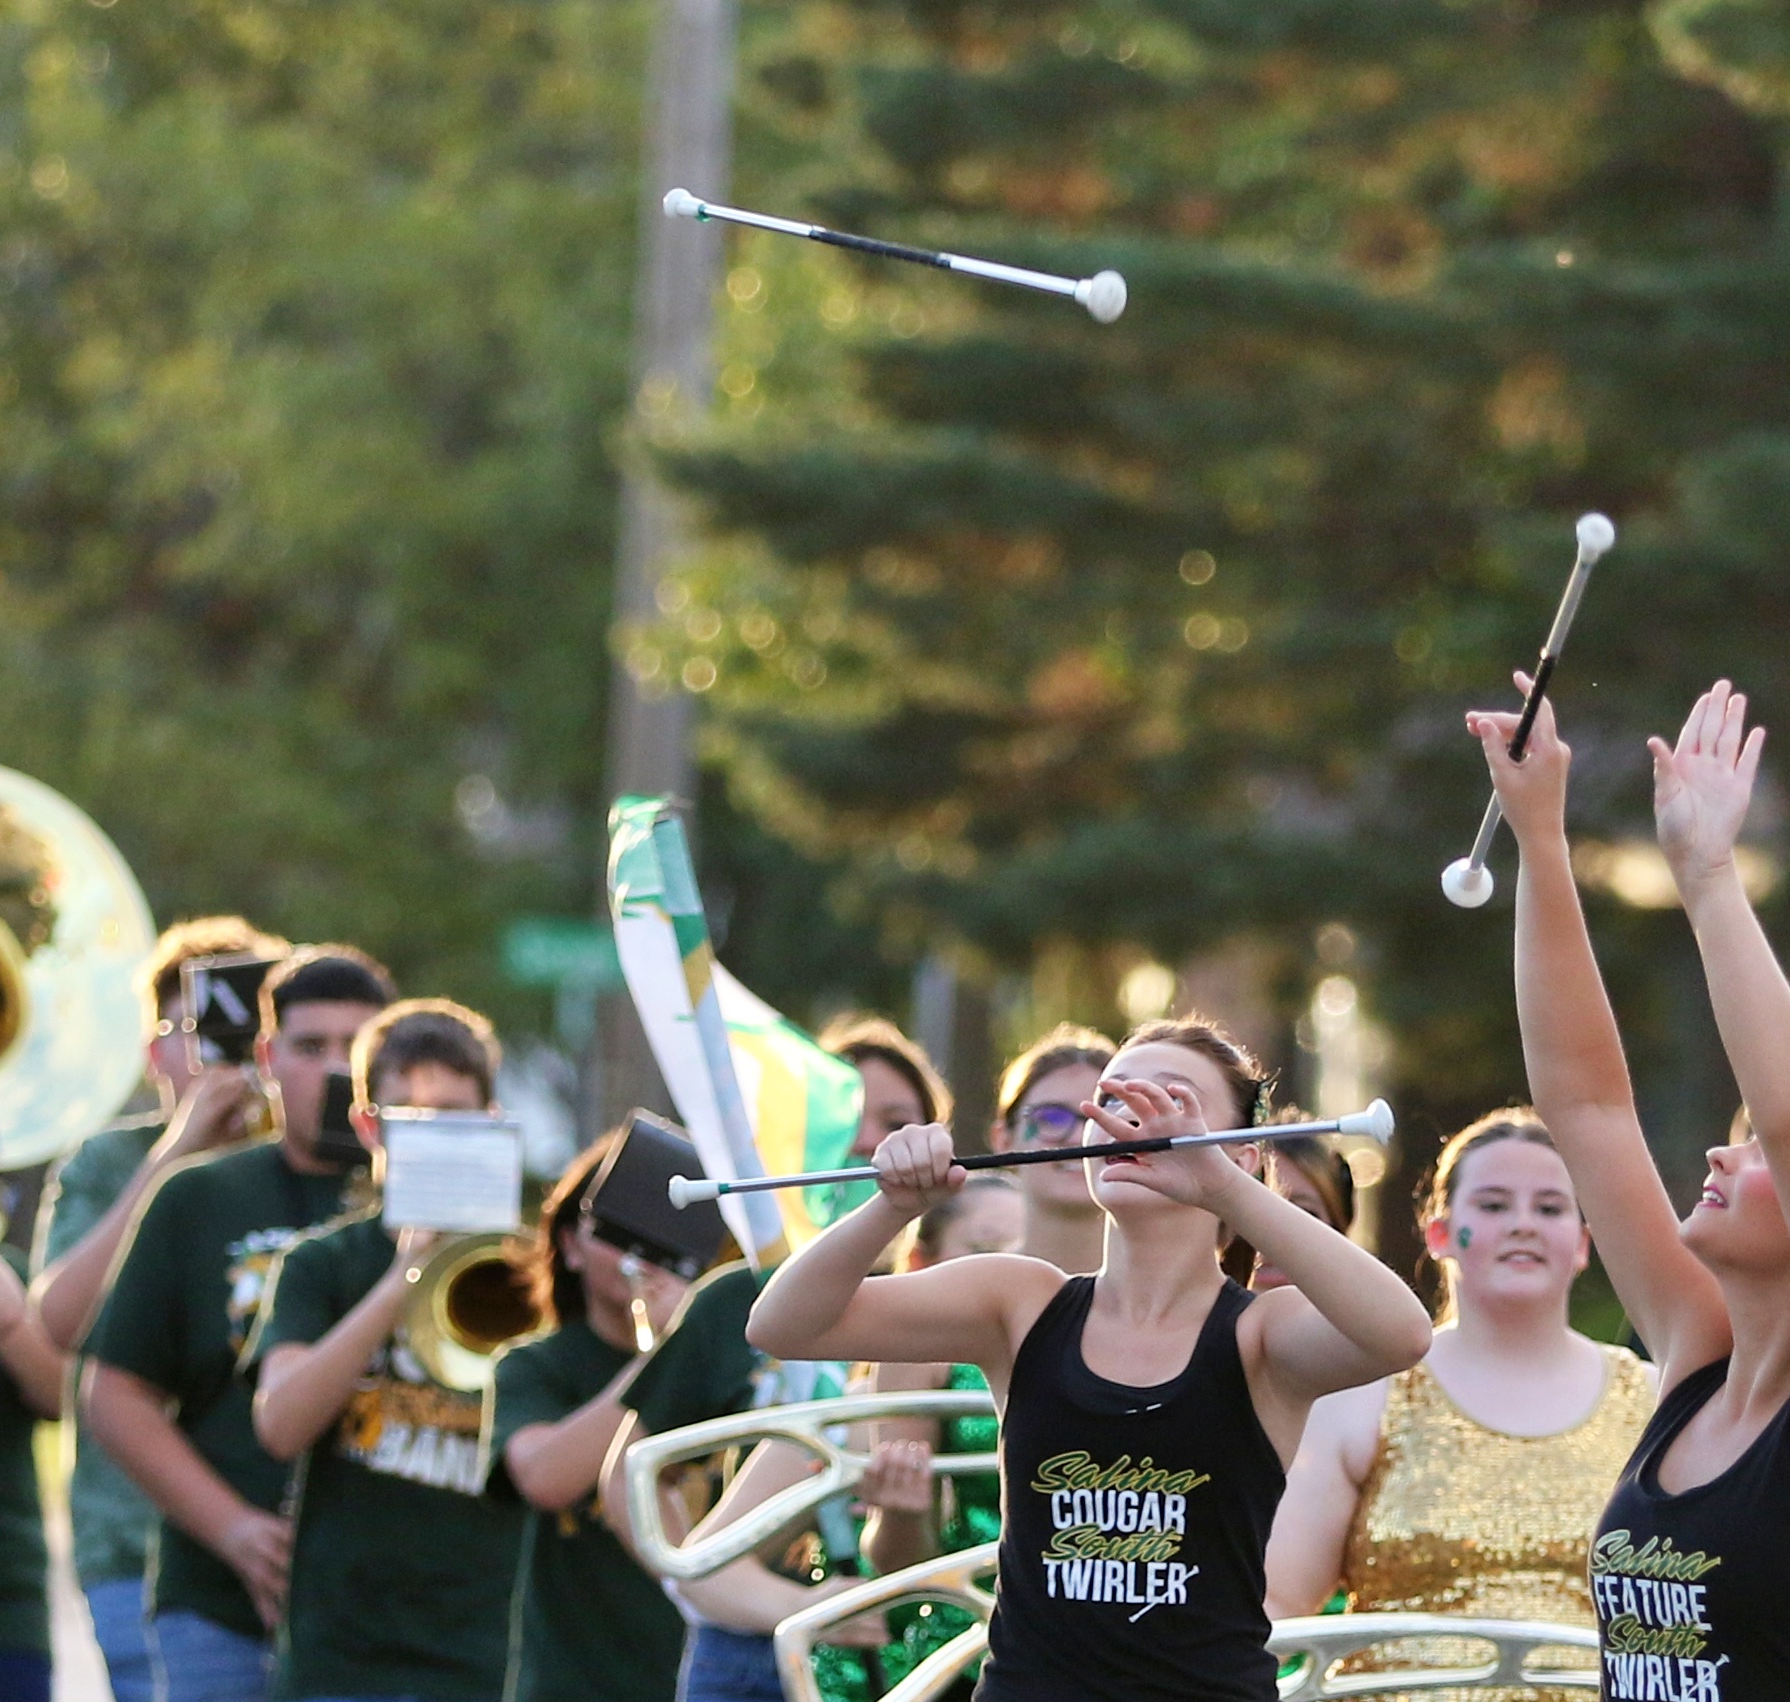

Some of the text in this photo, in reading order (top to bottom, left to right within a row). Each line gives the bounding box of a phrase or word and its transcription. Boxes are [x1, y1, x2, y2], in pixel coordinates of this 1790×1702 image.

[1030, 1451, 1211, 1494] Salina
[1052, 1489, 1186, 1534] COUGAR
[1041, 1523, 1183, 1562] South
[1590, 1529, 1721, 1580] Salina
[1042, 1556, 1188, 1604] TWIRLER
[1594, 1575, 1712, 1631] FEATURE
[1606, 1613, 1708, 1658] South
